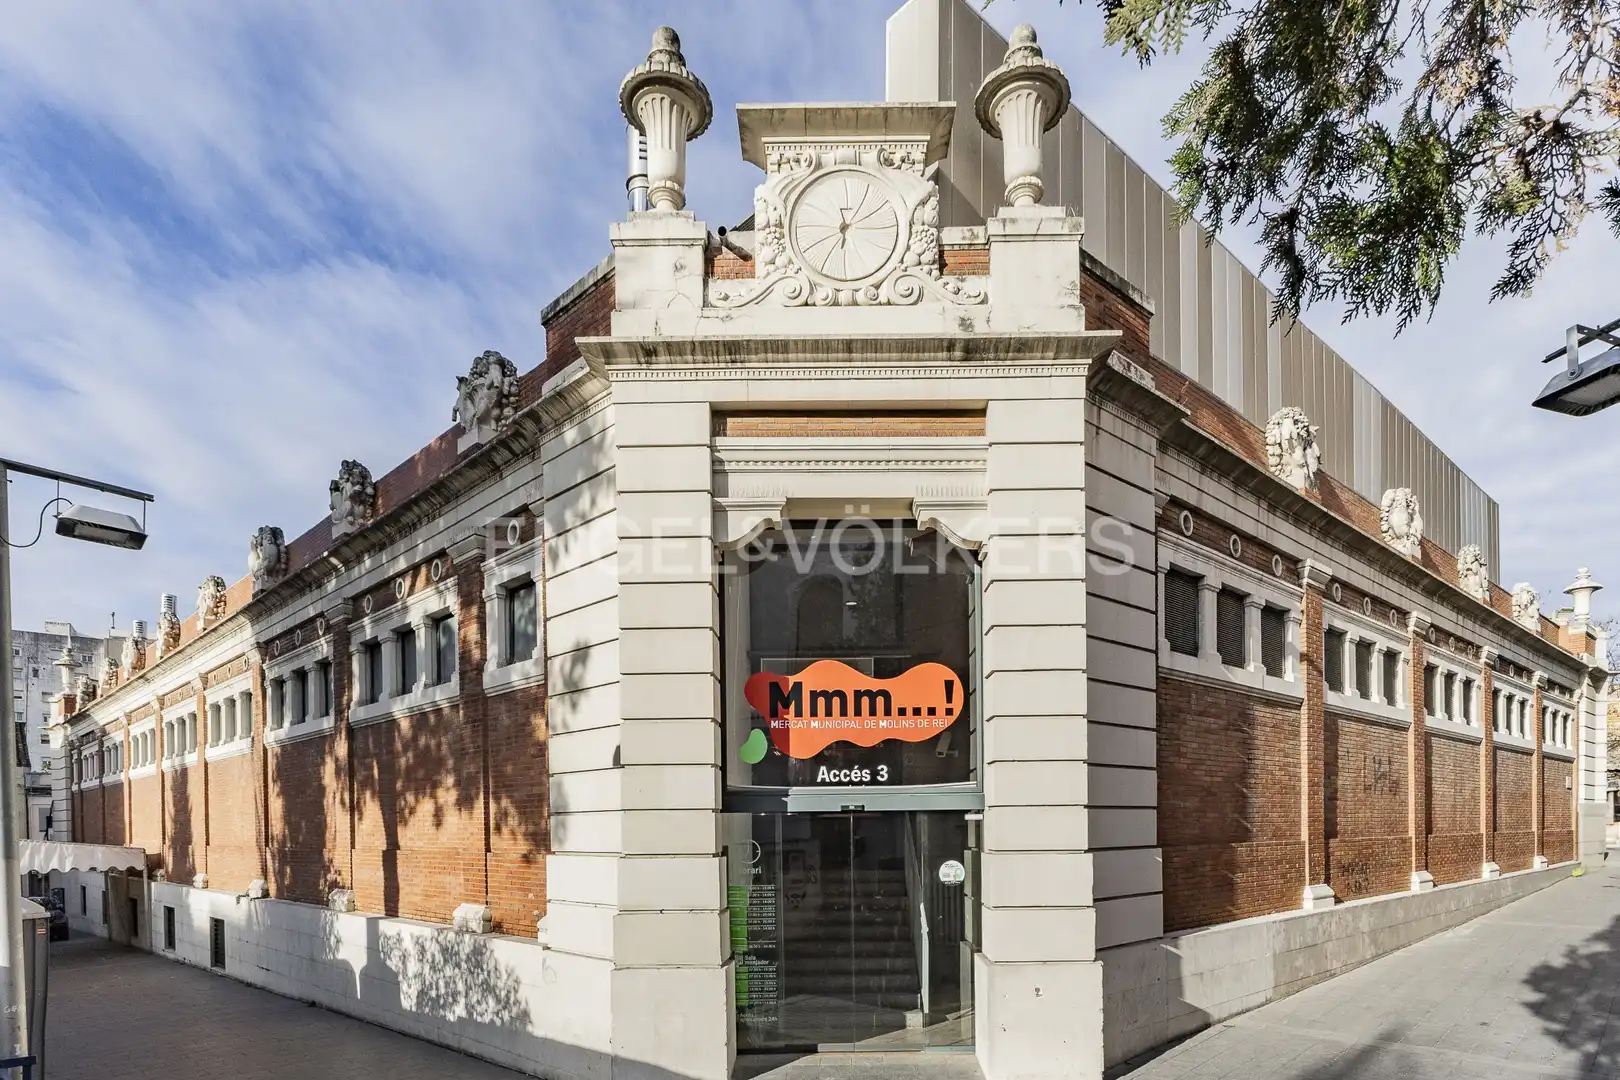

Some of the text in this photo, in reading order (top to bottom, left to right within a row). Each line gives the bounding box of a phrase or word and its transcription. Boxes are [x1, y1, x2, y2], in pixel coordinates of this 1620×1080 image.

[770, 719, 948, 729] MERCAT MUNICIPAL DE MOLINS DE REI
[817, 764, 889, 782] Accés 3
